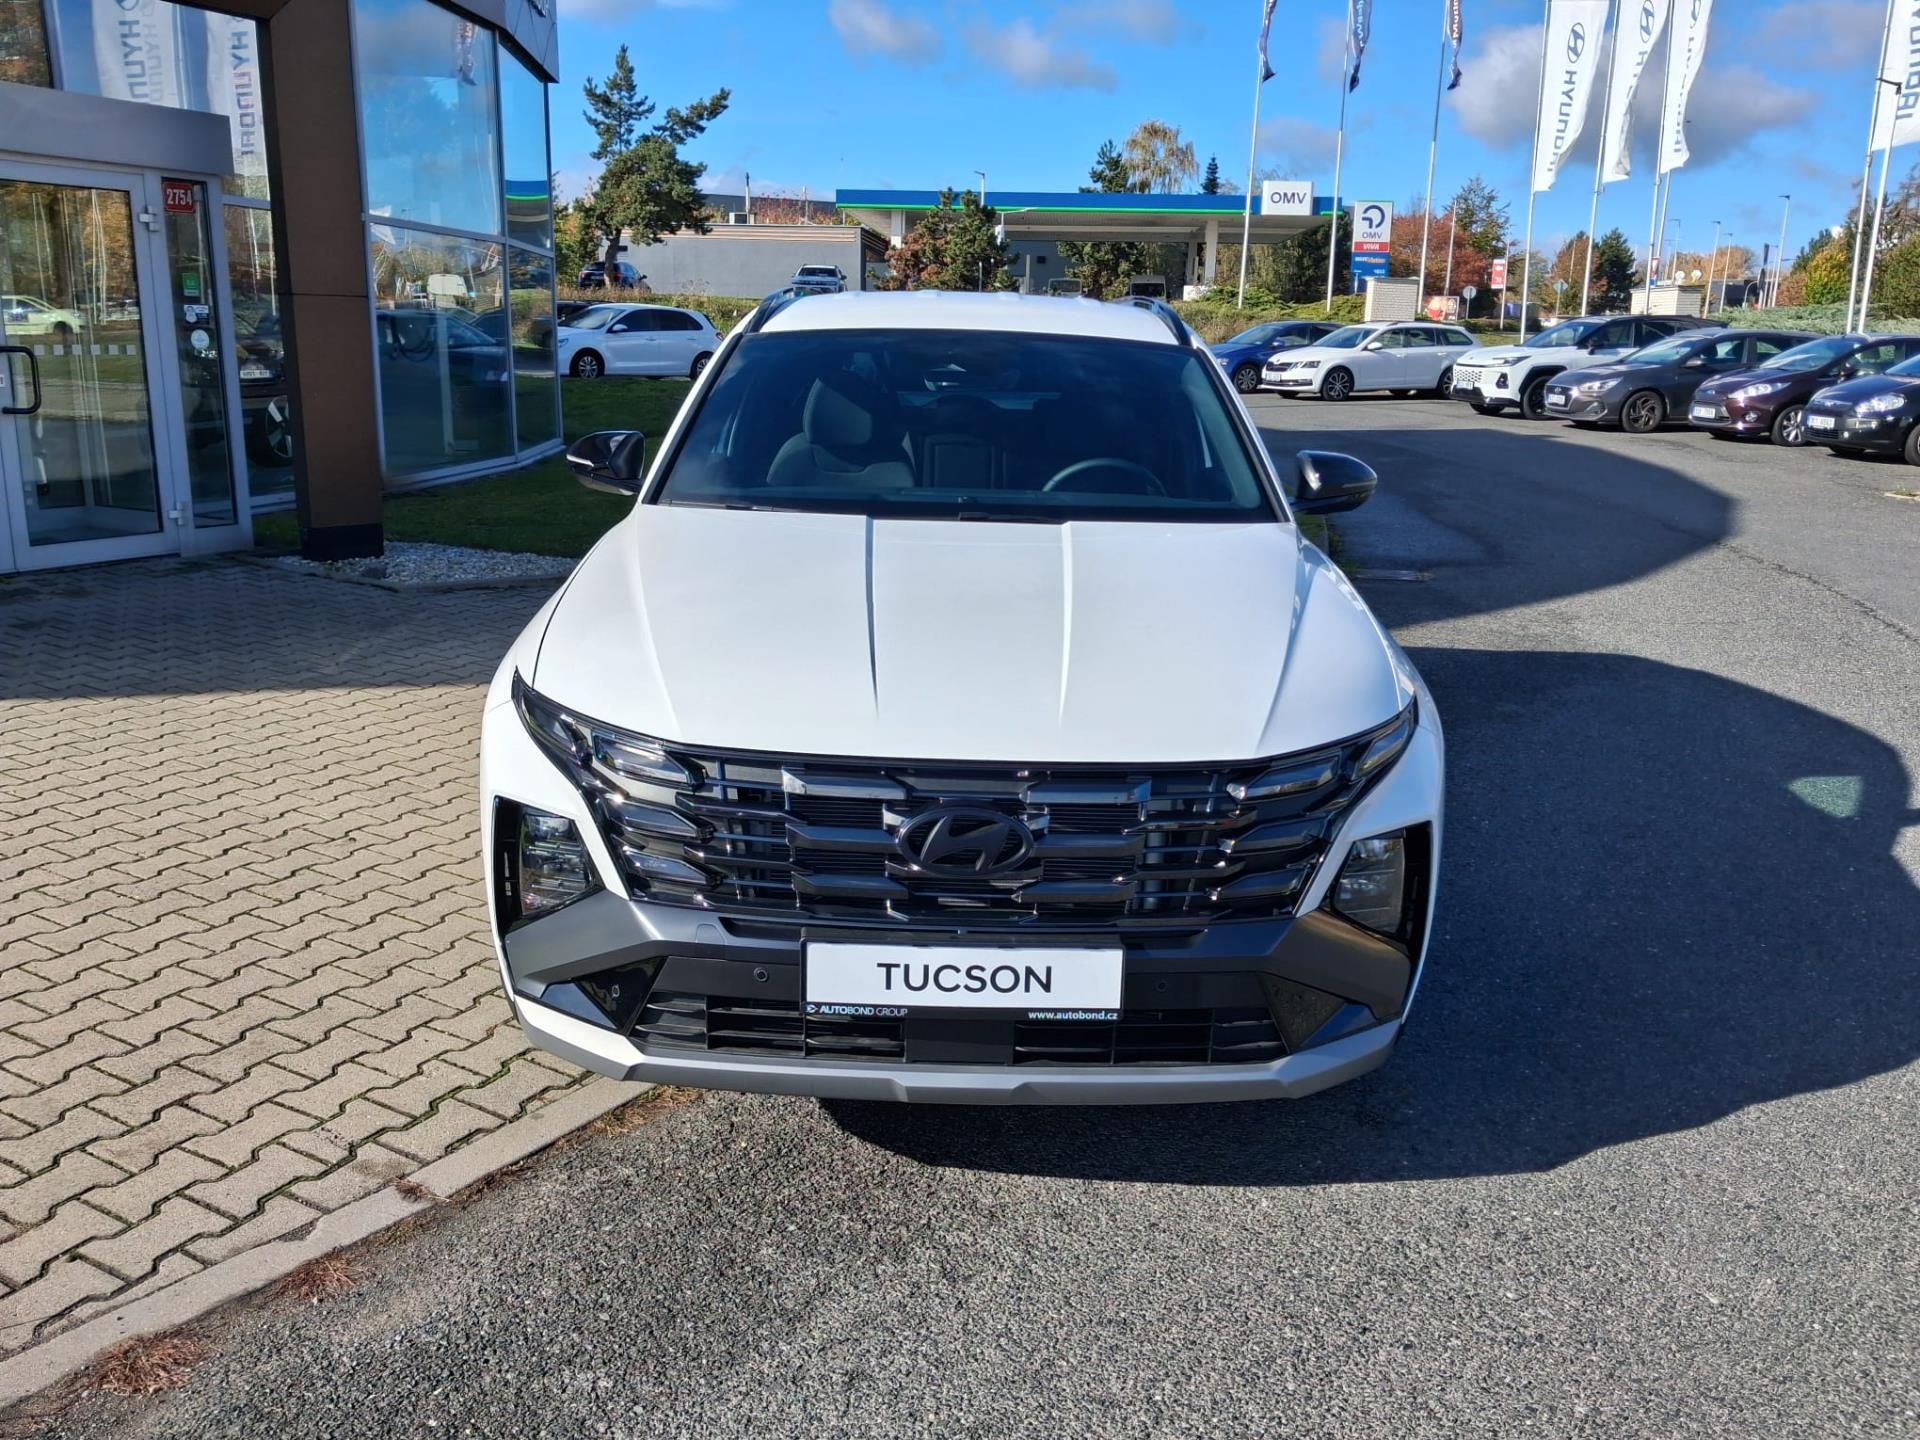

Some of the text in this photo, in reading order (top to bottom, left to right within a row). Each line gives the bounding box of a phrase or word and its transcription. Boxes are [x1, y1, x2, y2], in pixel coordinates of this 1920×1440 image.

[166, 188, 192, 206] 2754
[1270, 191, 1307, 205] OMV
[1362, 231, 1383, 239] OMV
[877, 962, 1052, 993] TUCSON
[819, 1005, 908, 1017] AUTOBOND GROUP
[1028, 1010, 1118, 1021] www.autobond.cz
